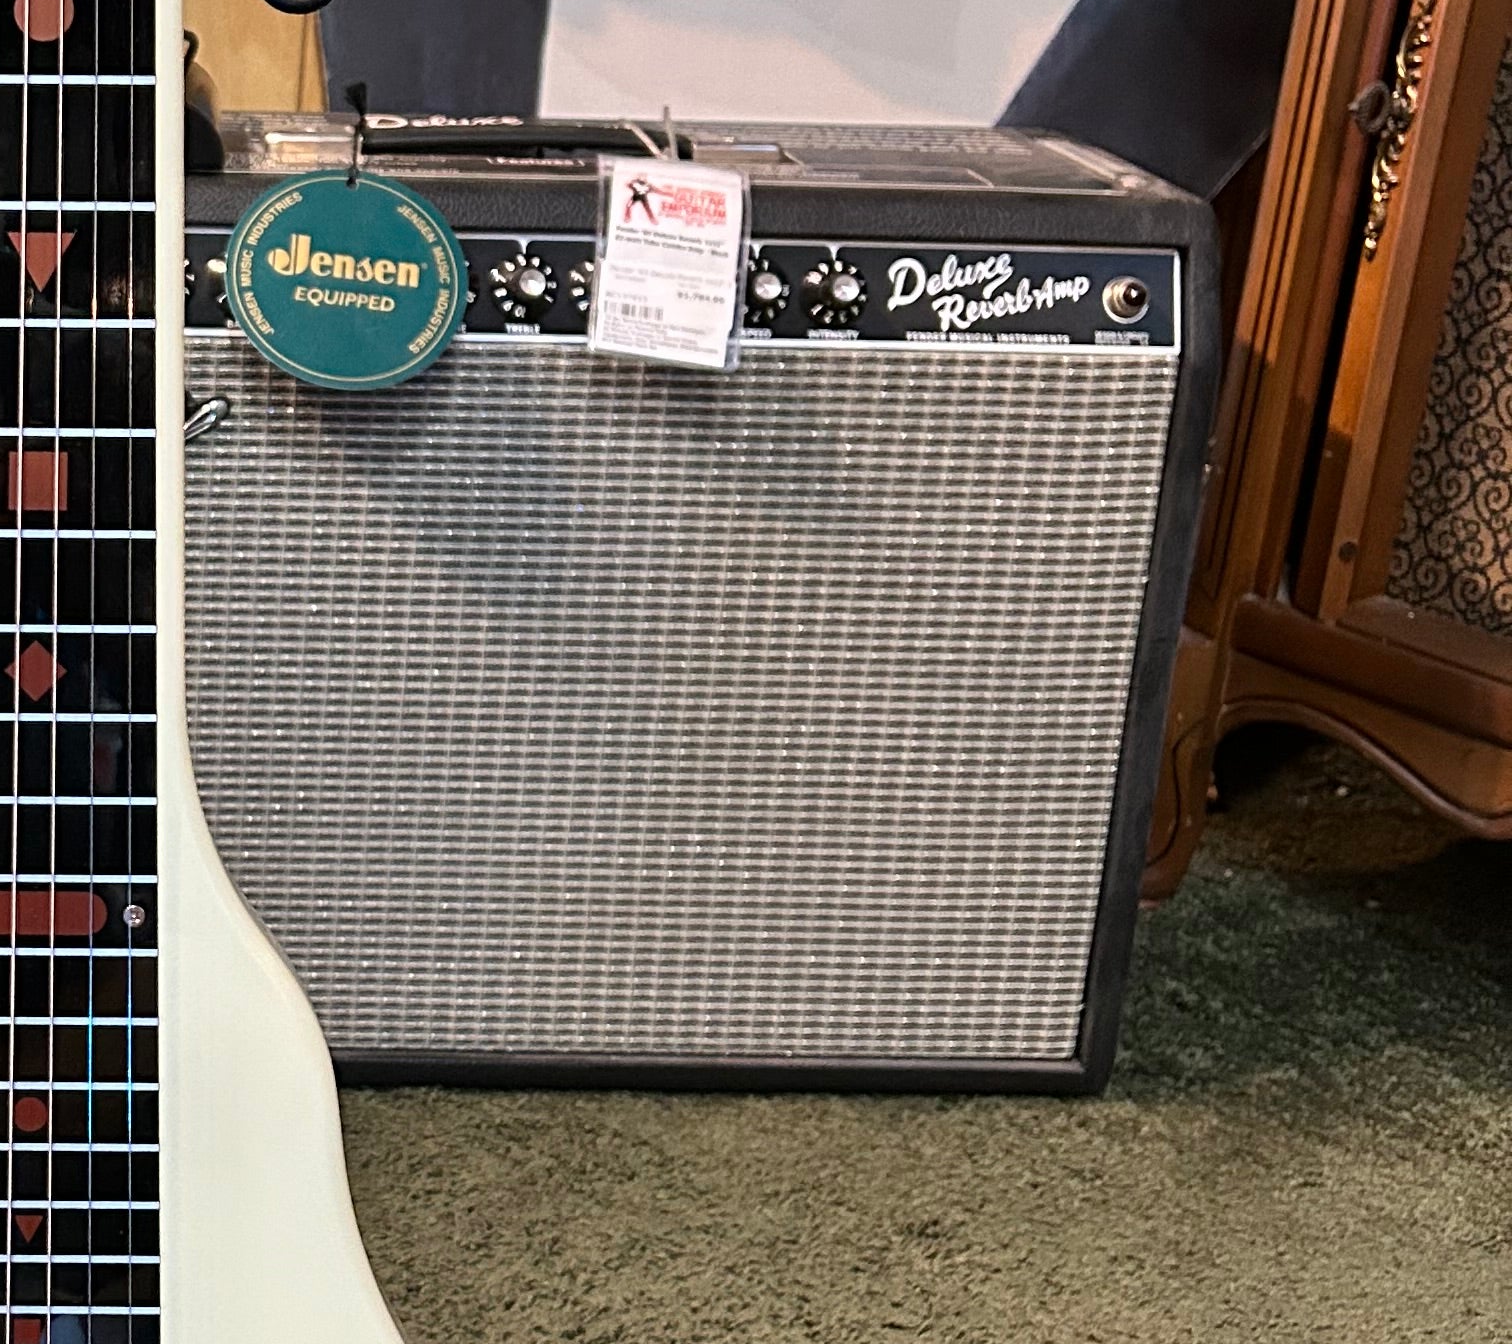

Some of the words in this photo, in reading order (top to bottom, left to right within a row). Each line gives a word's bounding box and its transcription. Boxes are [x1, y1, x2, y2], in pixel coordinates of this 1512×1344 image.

[247, 191, 304, 246] INDUSTRIES
[396, 204, 437, 244] JENSEN
[240, 249, 254, 287] MUSIC
[267, 232, 421, 289] Jensen
[432, 245, 451, 285] MUSIC
[887, 253, 1015, 311] Deluxe
[244, 291, 275, 336] JENSEN
[293, 285, 396, 313] EQUIPPED
[408, 288, 451, 355] INDUSTRIES
[931, 274, 1034, 332] Reverb
